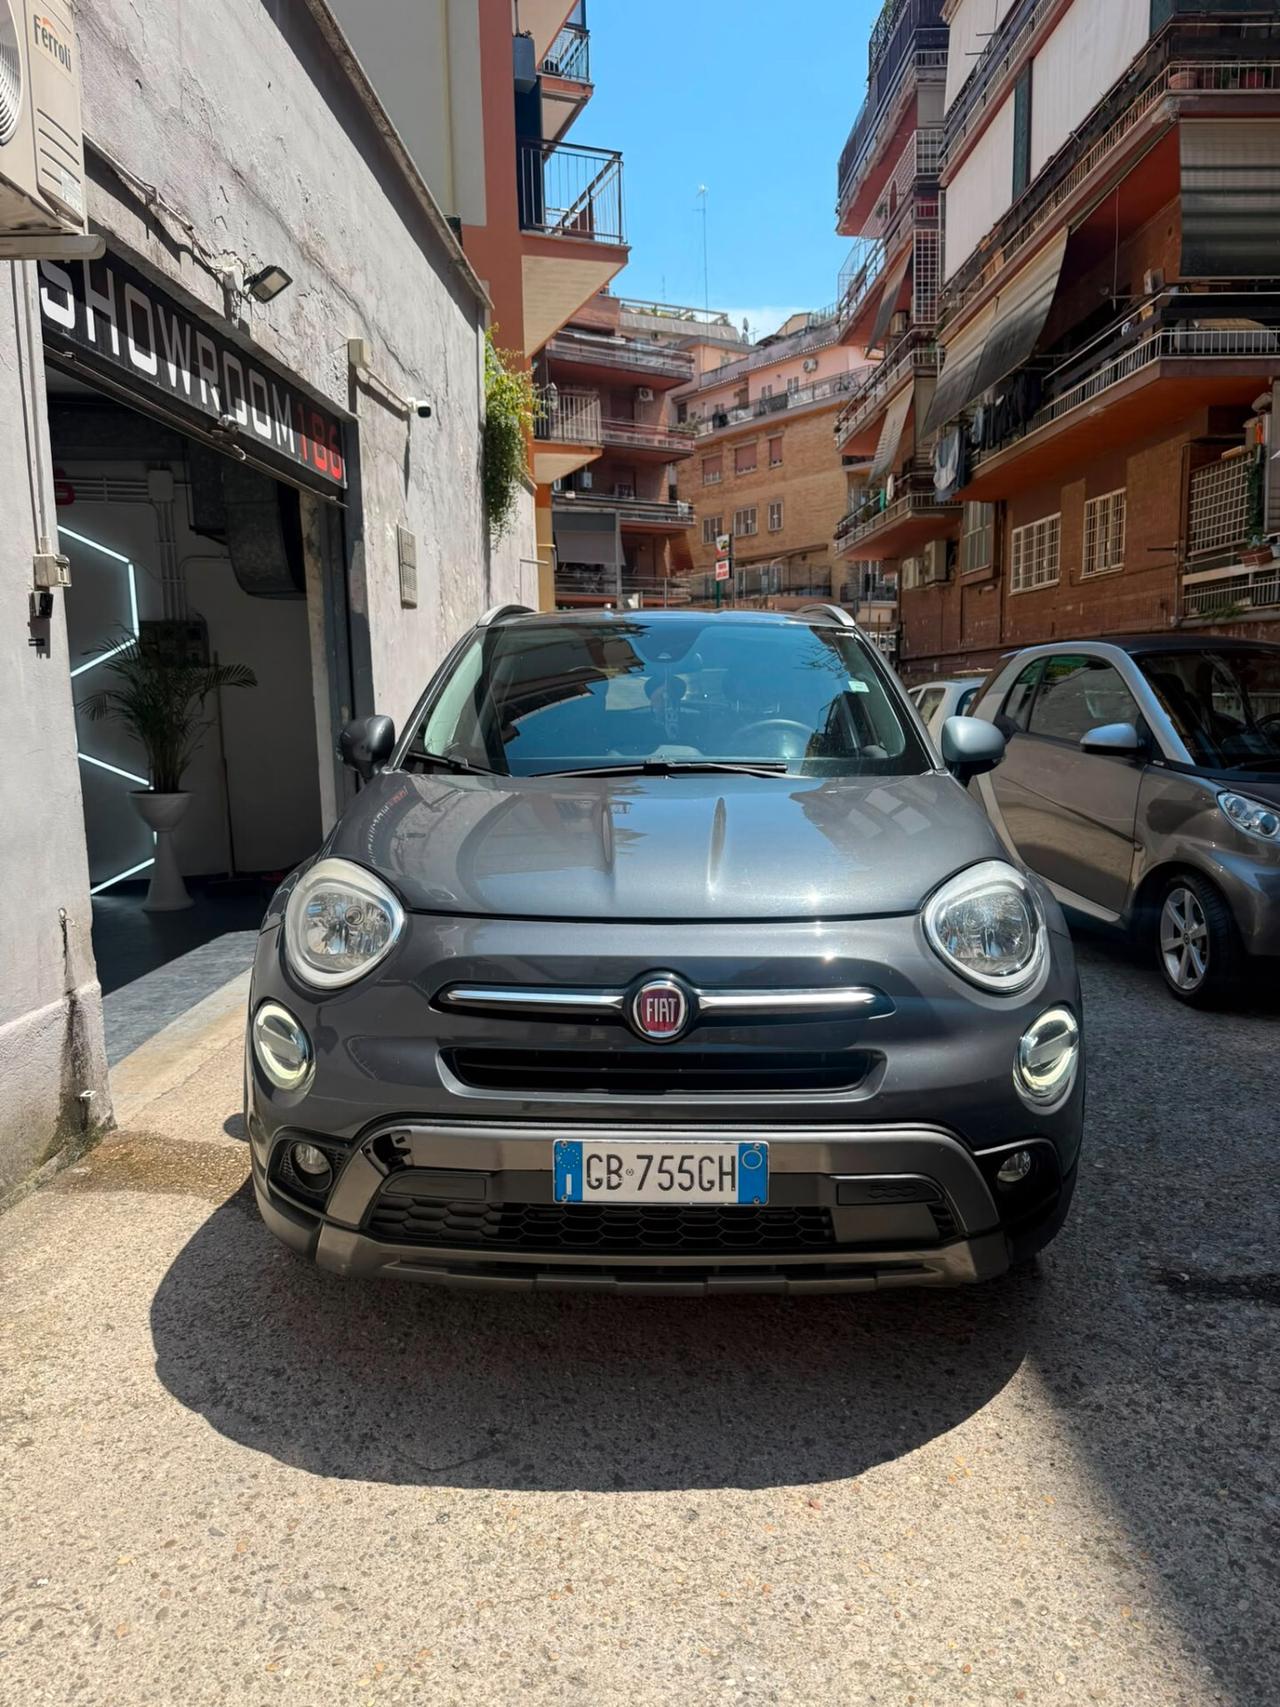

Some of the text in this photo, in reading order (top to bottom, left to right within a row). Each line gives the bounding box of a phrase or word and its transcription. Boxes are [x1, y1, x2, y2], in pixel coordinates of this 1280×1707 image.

[33, 14, 72, 73] Ferroli
[38, 258, 295, 453] SHOWROOM
[646, 998, 677, 1023] FIAT
[586, 1154, 736, 1191] GB 755GH
